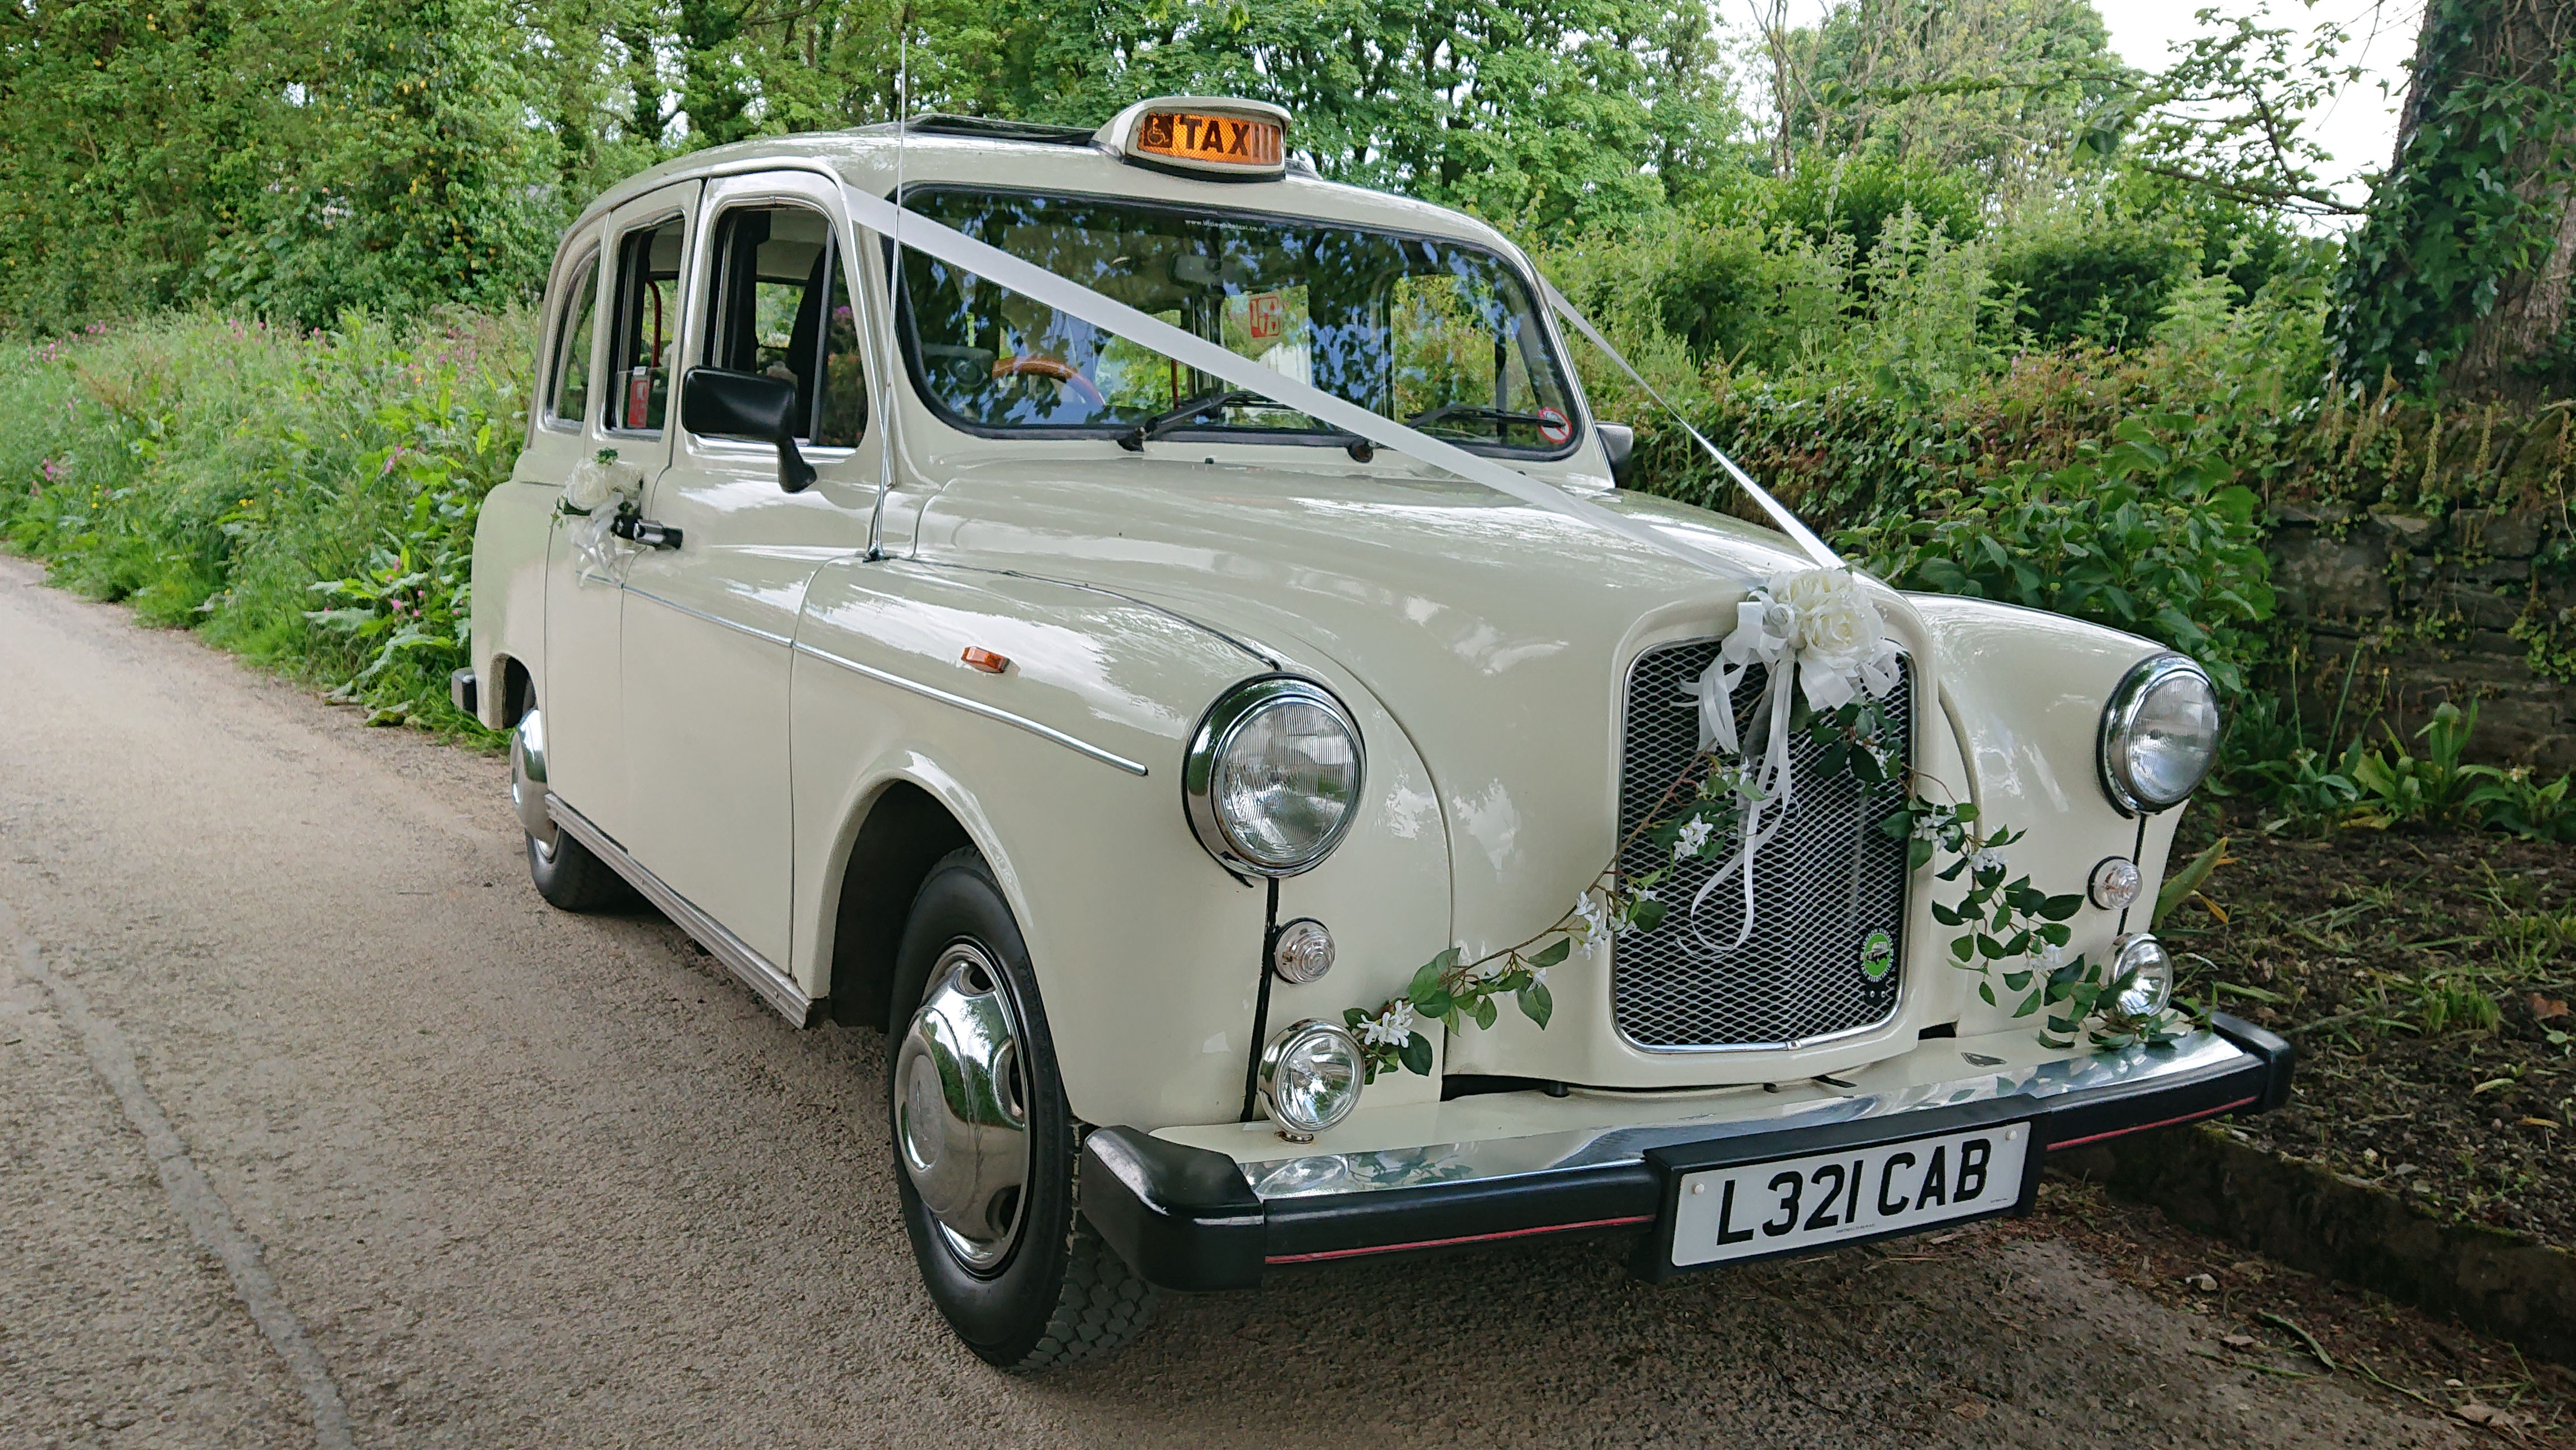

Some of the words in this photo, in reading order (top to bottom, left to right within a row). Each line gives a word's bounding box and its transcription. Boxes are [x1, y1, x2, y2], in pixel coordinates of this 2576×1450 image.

[1861, 928, 1878, 949] LONDON
[1879, 927, 1893, 947] VINTAGE
[1867, 959, 1894, 983] ASSOCIATION
[1716, 1159, 1864, 1245] L321
[1877, 1138, 1991, 1216] CAB
